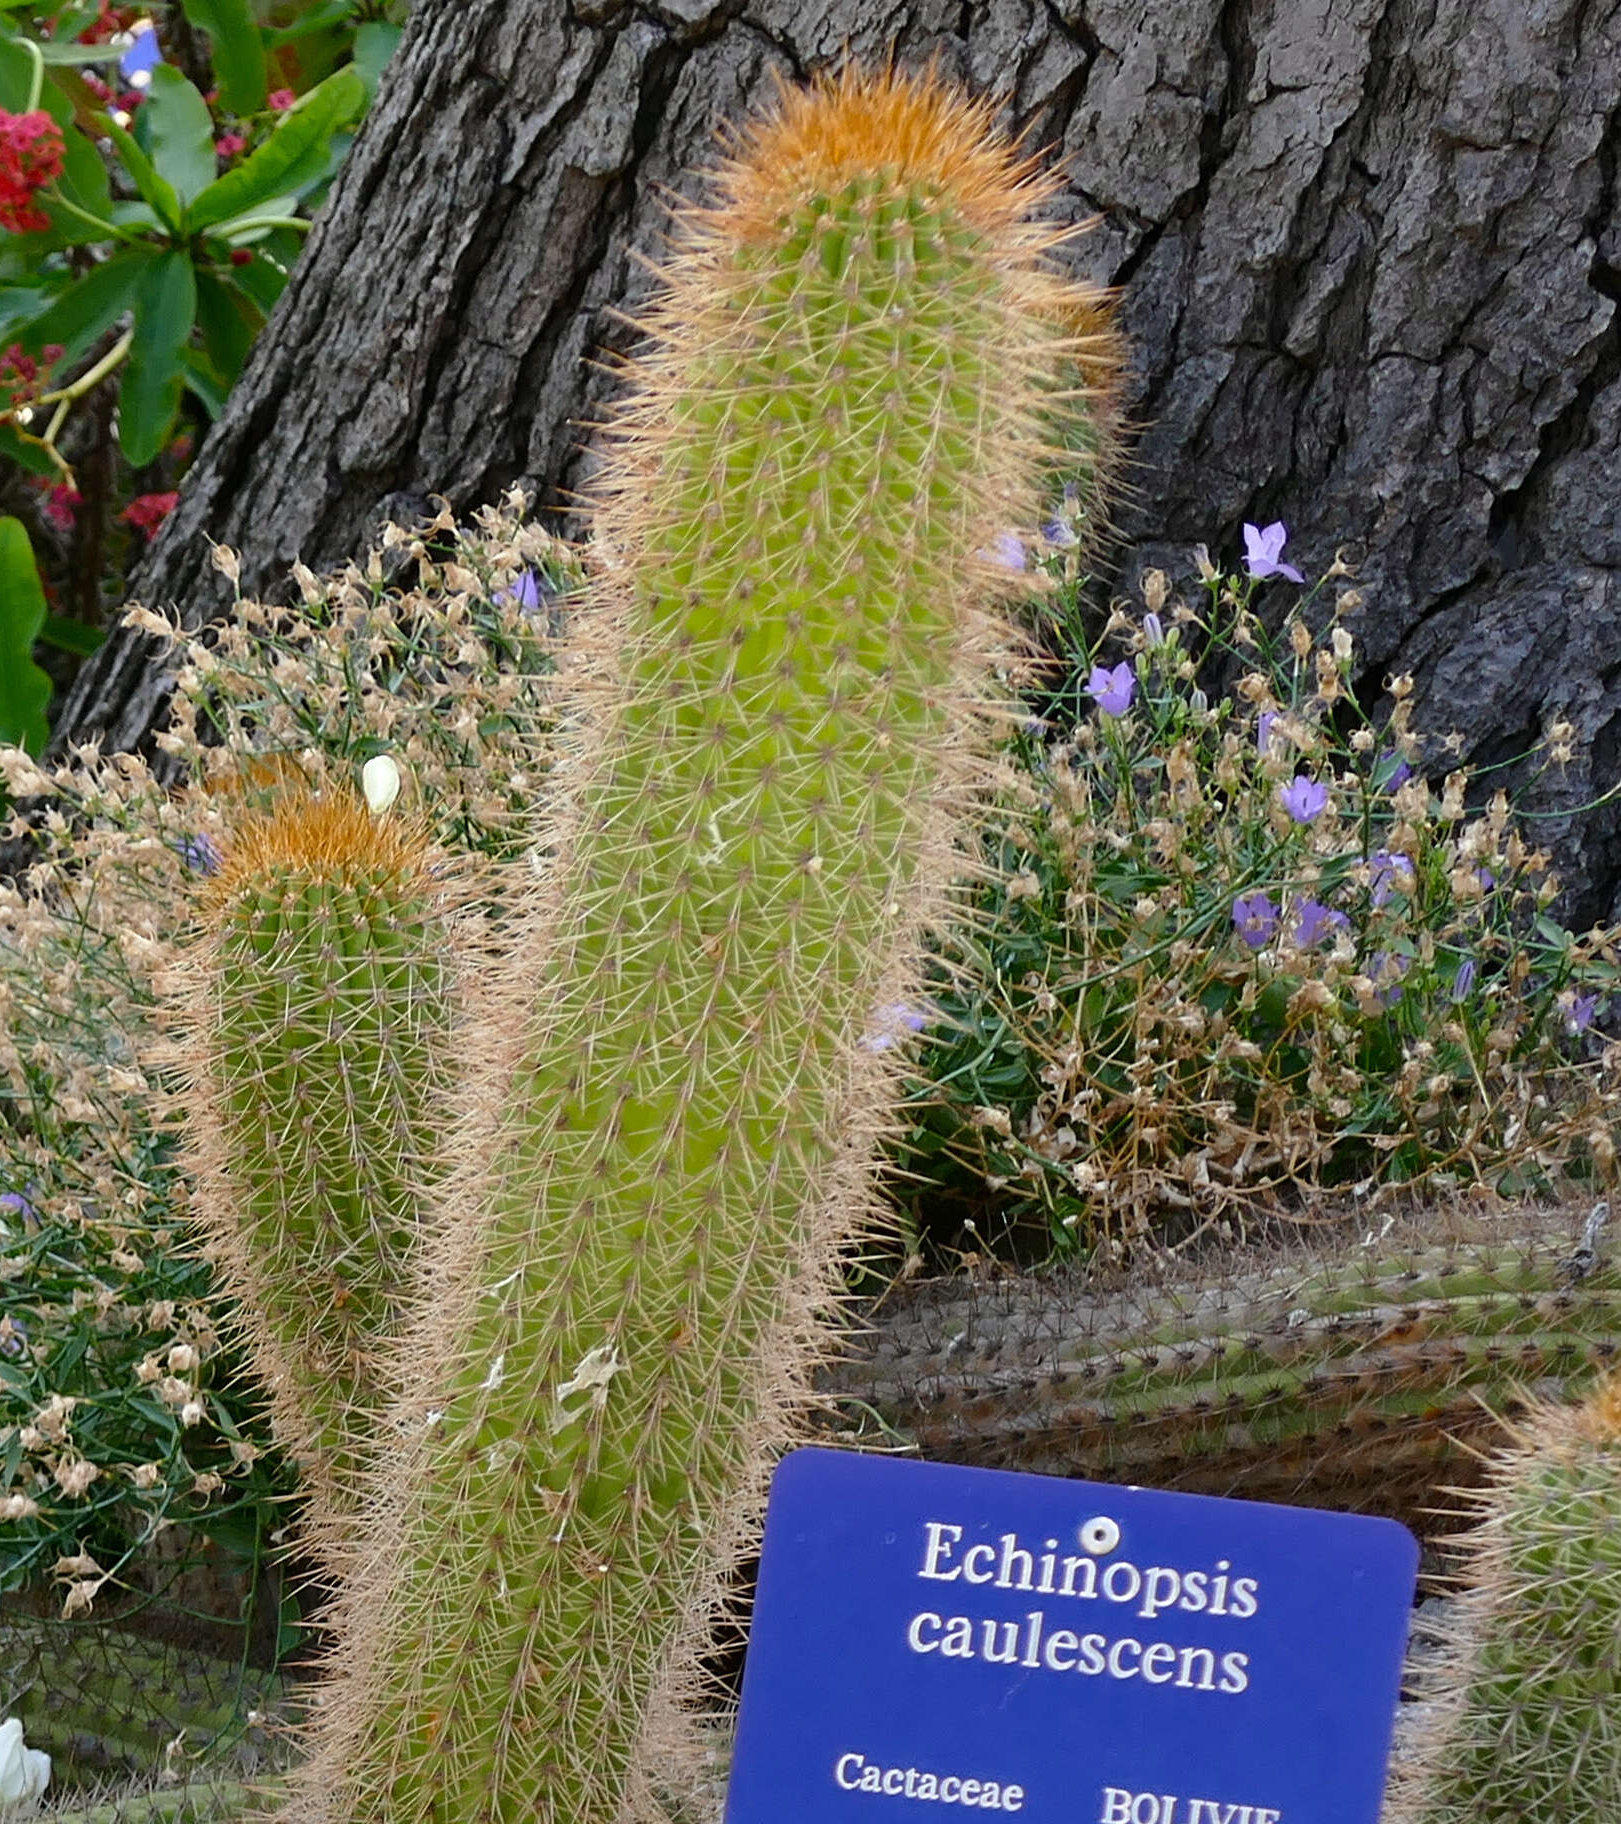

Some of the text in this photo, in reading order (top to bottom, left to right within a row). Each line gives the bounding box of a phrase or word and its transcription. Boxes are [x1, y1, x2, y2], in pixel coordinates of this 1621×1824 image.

[918, 1521, 1260, 1619] Echinopsis
[908, 1611, 1250, 1695] caulescens
[835, 1752, 1025, 1813] Cactaceae
